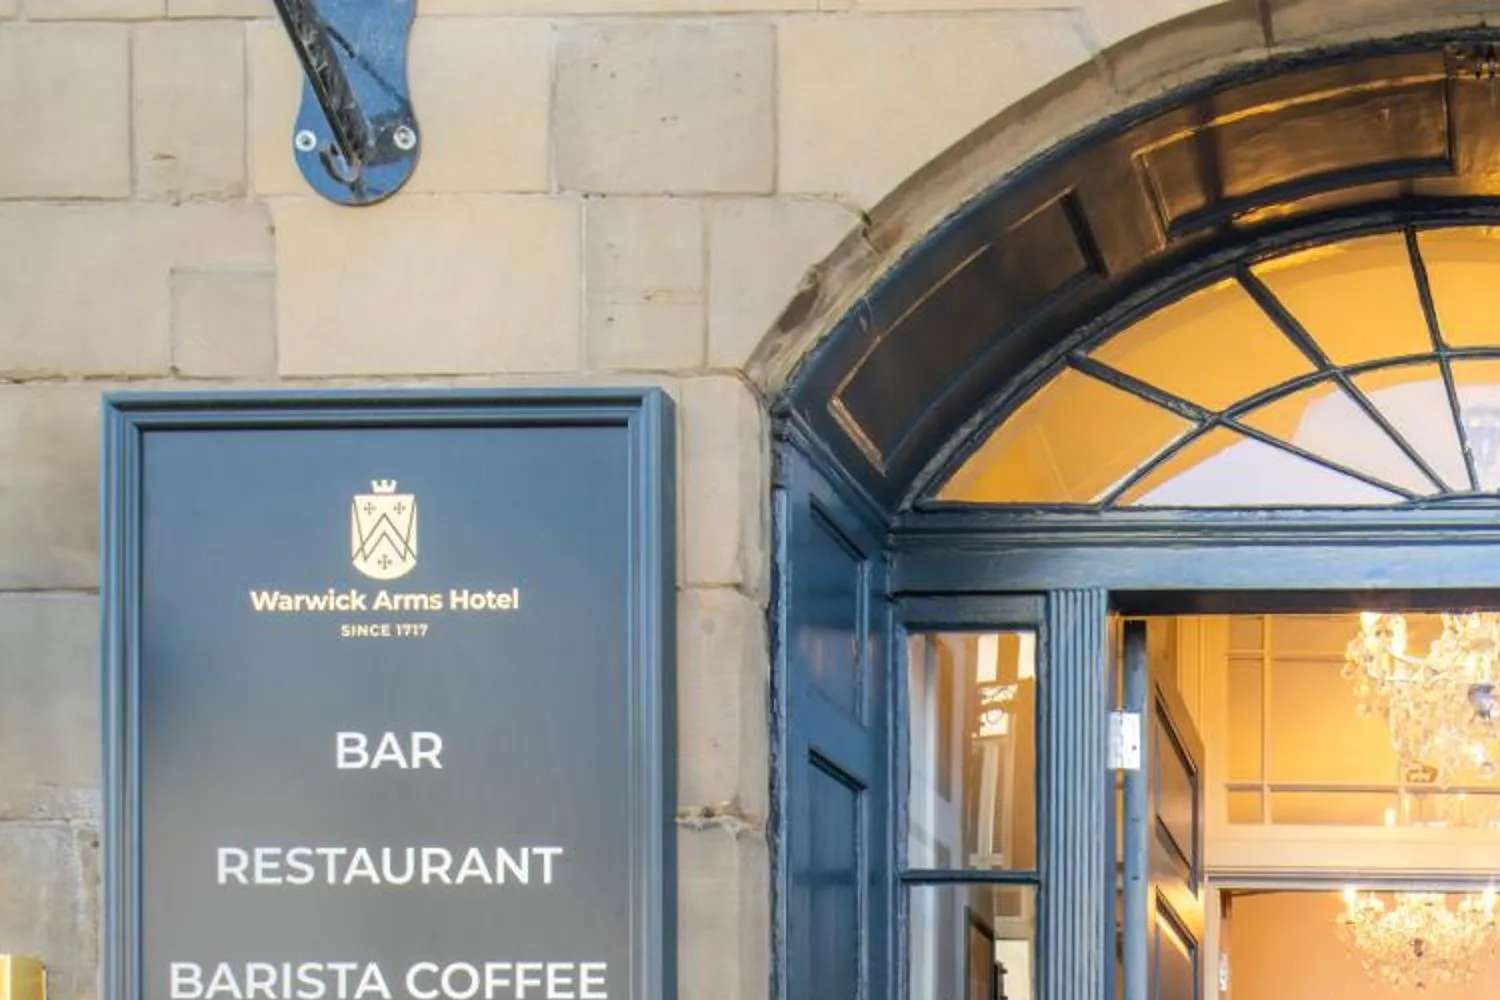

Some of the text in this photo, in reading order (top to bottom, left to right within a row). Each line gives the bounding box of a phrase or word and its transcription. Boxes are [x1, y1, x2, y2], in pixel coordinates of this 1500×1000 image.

[250, 587, 519, 611] Warwick Arms Hotel
[341, 623, 428, 637] SINCE 1717
[336, 731, 443, 770] BAR
[217, 846, 563, 885] RESTAURANT
[170, 961, 608, 1000] BARISTA COFFEE
